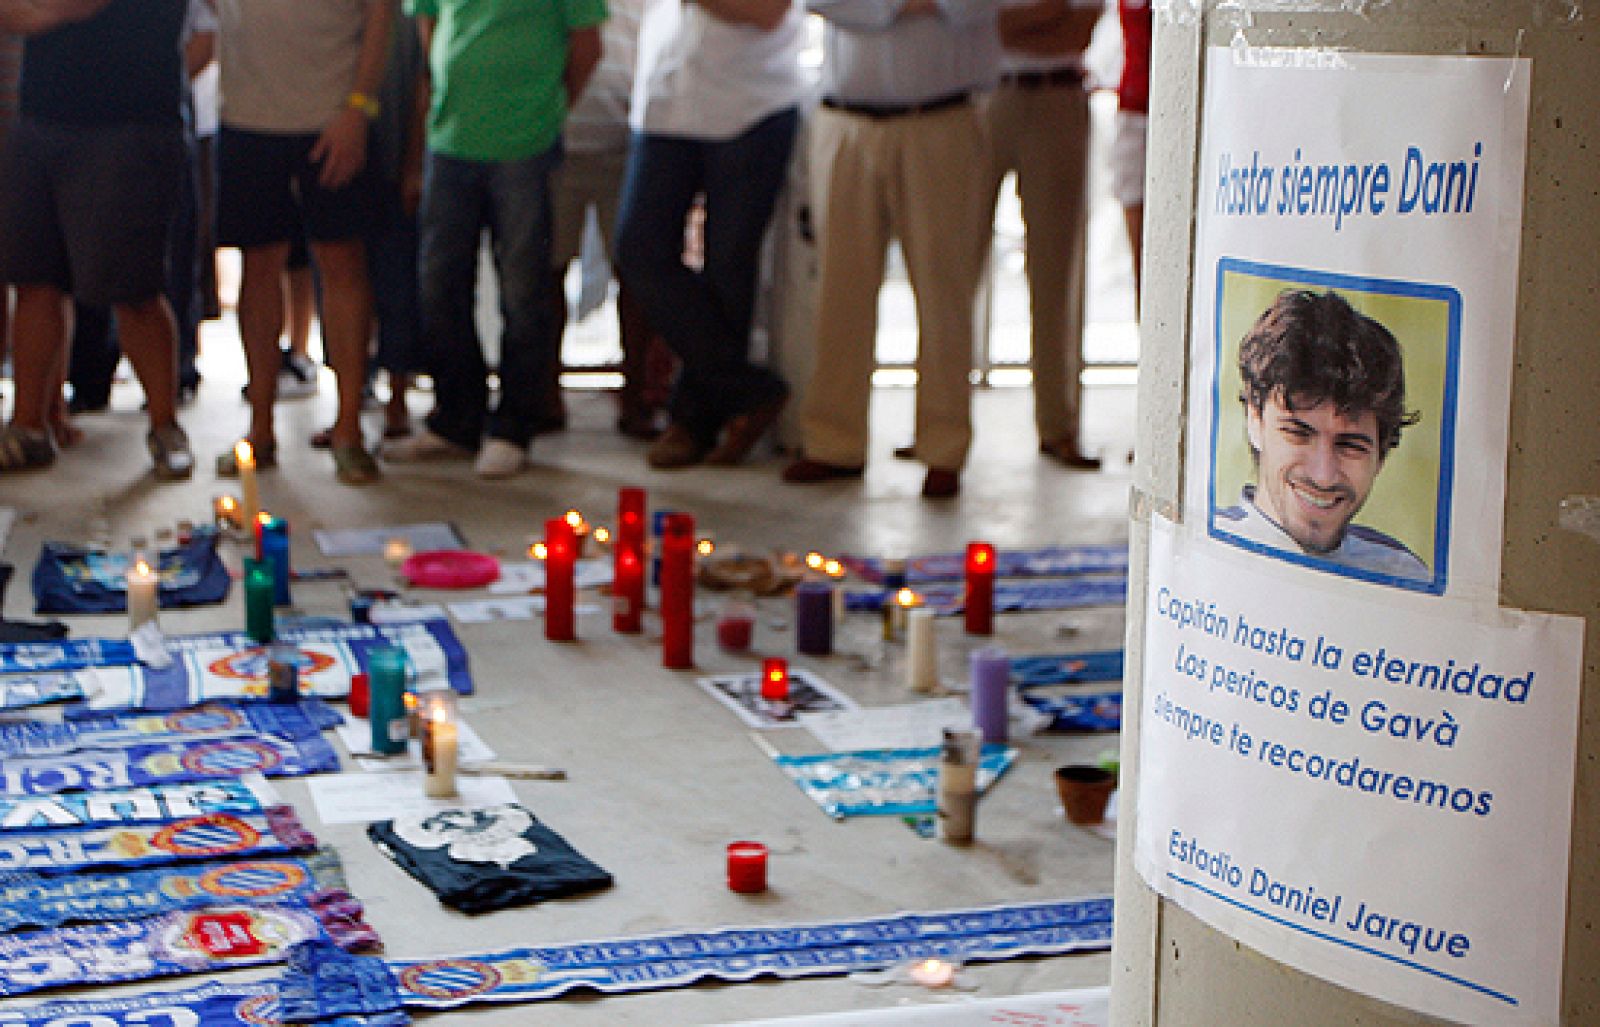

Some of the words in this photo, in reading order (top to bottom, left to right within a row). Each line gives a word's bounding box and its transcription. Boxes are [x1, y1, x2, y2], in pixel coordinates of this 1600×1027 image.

[1215, 150, 1274, 216] Hasta
[1277, 147, 1391, 231] siempre
[1397, 141, 1482, 214] Dani
[1157, 586, 1229, 637] Capitán
[1233, 614, 1305, 661] hasta
[1311, 636, 1343, 670] la
[1352, 648, 1535, 704] eternidad
[1175, 644, 1208, 679] Los
[1209, 664, 1301, 713] pericos
[1308, 690, 1350, 724] de
[1360, 700, 1460, 748] Gavà
[1153, 691, 1224, 742] siempre
[1229, 723, 1254, 756] te
[1258, 738, 1494, 816] recordaremos
[1168, 828, 1243, 888] Estadio
[1249, 867, 1342, 923] Daniel
[1346, 902, 1471, 959] Jarque
